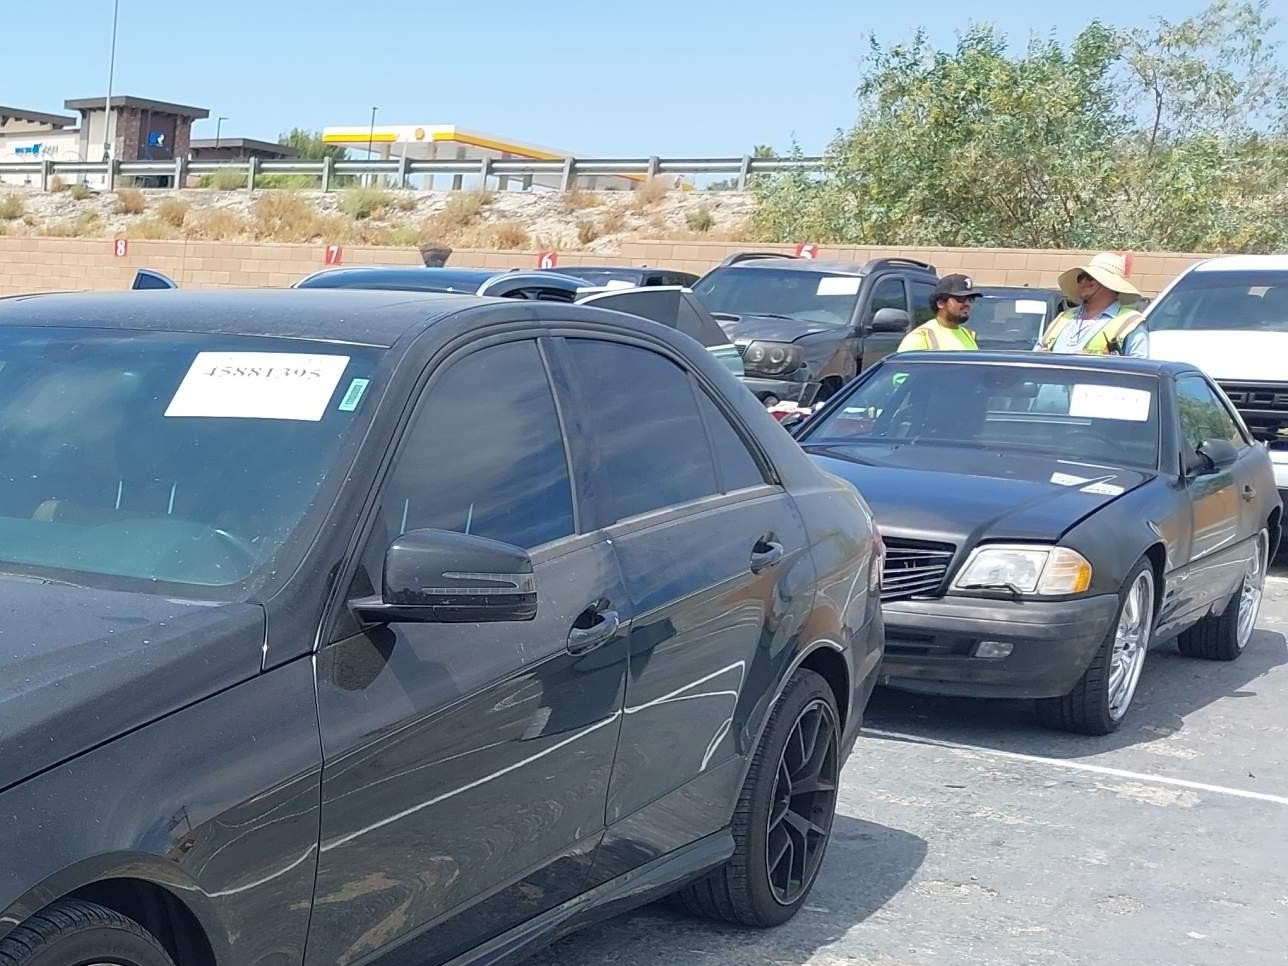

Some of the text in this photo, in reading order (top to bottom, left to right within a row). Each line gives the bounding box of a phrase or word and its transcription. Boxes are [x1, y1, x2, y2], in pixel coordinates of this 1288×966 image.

[116, 239, 126, 256] 8
[328, 246, 338, 263] 7
[800, 245, 814, 259] 5
[541, 252, 553, 268] 6
[203, 366, 321, 380] 45881395
